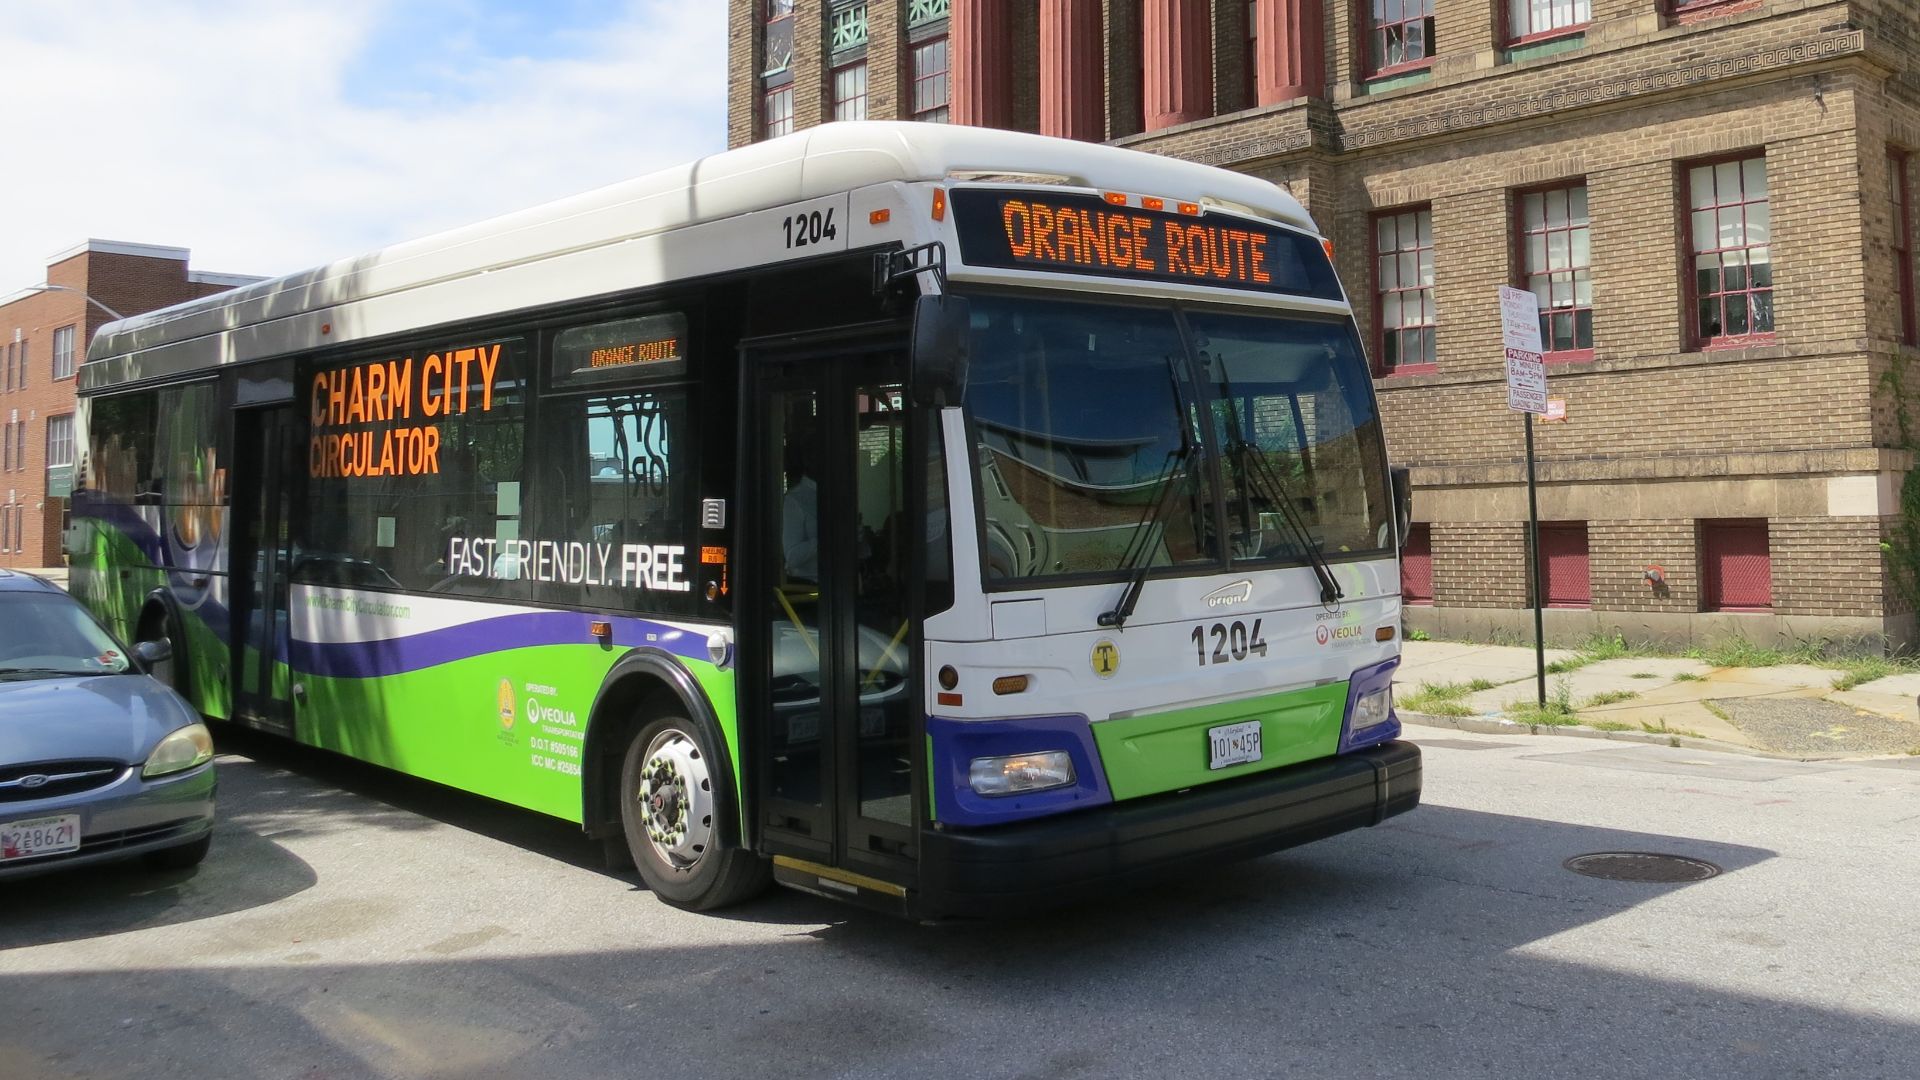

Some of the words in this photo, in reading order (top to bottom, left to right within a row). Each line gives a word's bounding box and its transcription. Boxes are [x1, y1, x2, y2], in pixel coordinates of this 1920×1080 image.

[783, 207, 836, 249] 1204
[1003, 200, 1155, 271] ORANGE
[1165, 221, 1270, 283] ROUTE
[591, 345, 635, 368] ORANGE
[639, 339, 677, 361] ROUTE
[1507, 349, 1542, 363] PARKING
[311, 358, 412, 428] CHARM
[422, 344, 501, 417] CITY
[310, 426, 440, 478] CIRCULATOR
[505, 540, 613, 587] FRIENDLY.
[622, 543, 690, 592] FREE.
[1191, 618, 1268, 666] 1204
[1330, 625, 1362, 639] VEOLIA
[1097, 645, 1113, 672] T
[540, 706, 577, 726] VEOLIA
